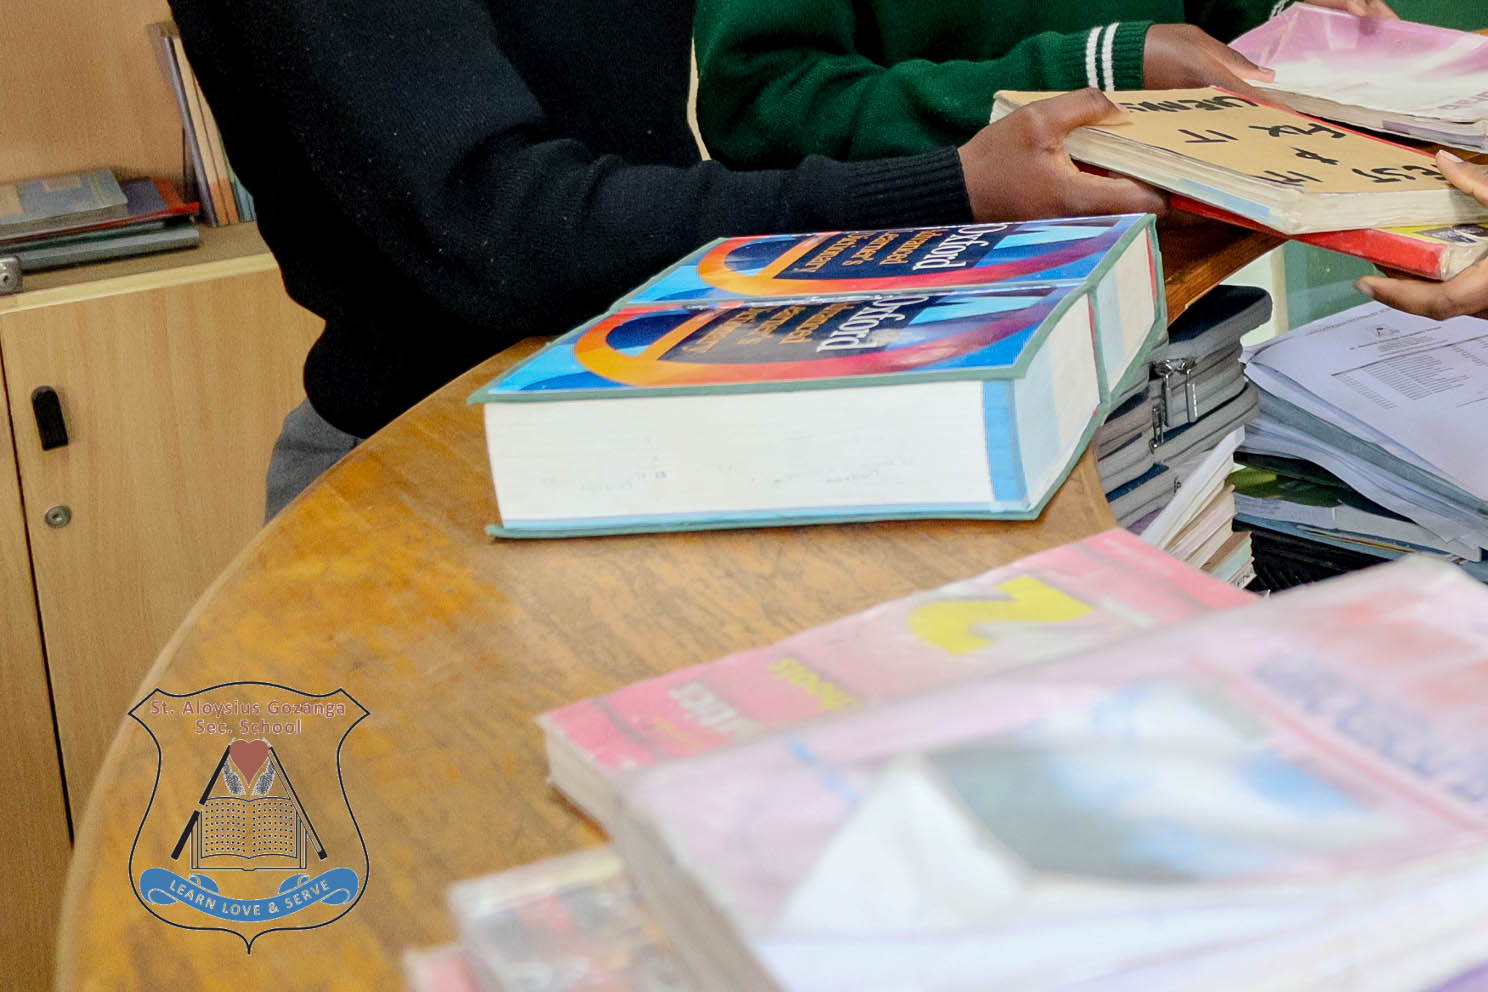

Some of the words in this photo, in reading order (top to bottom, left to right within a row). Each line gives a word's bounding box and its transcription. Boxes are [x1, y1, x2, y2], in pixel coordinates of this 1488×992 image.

[1177, 127, 1240, 144] IT
[1352, 164, 1450, 184] EST
[911, 222, 1010, 271] Oxford
[814, 295, 931, 353] Oxford
[908, 573, 1095, 656] 2
